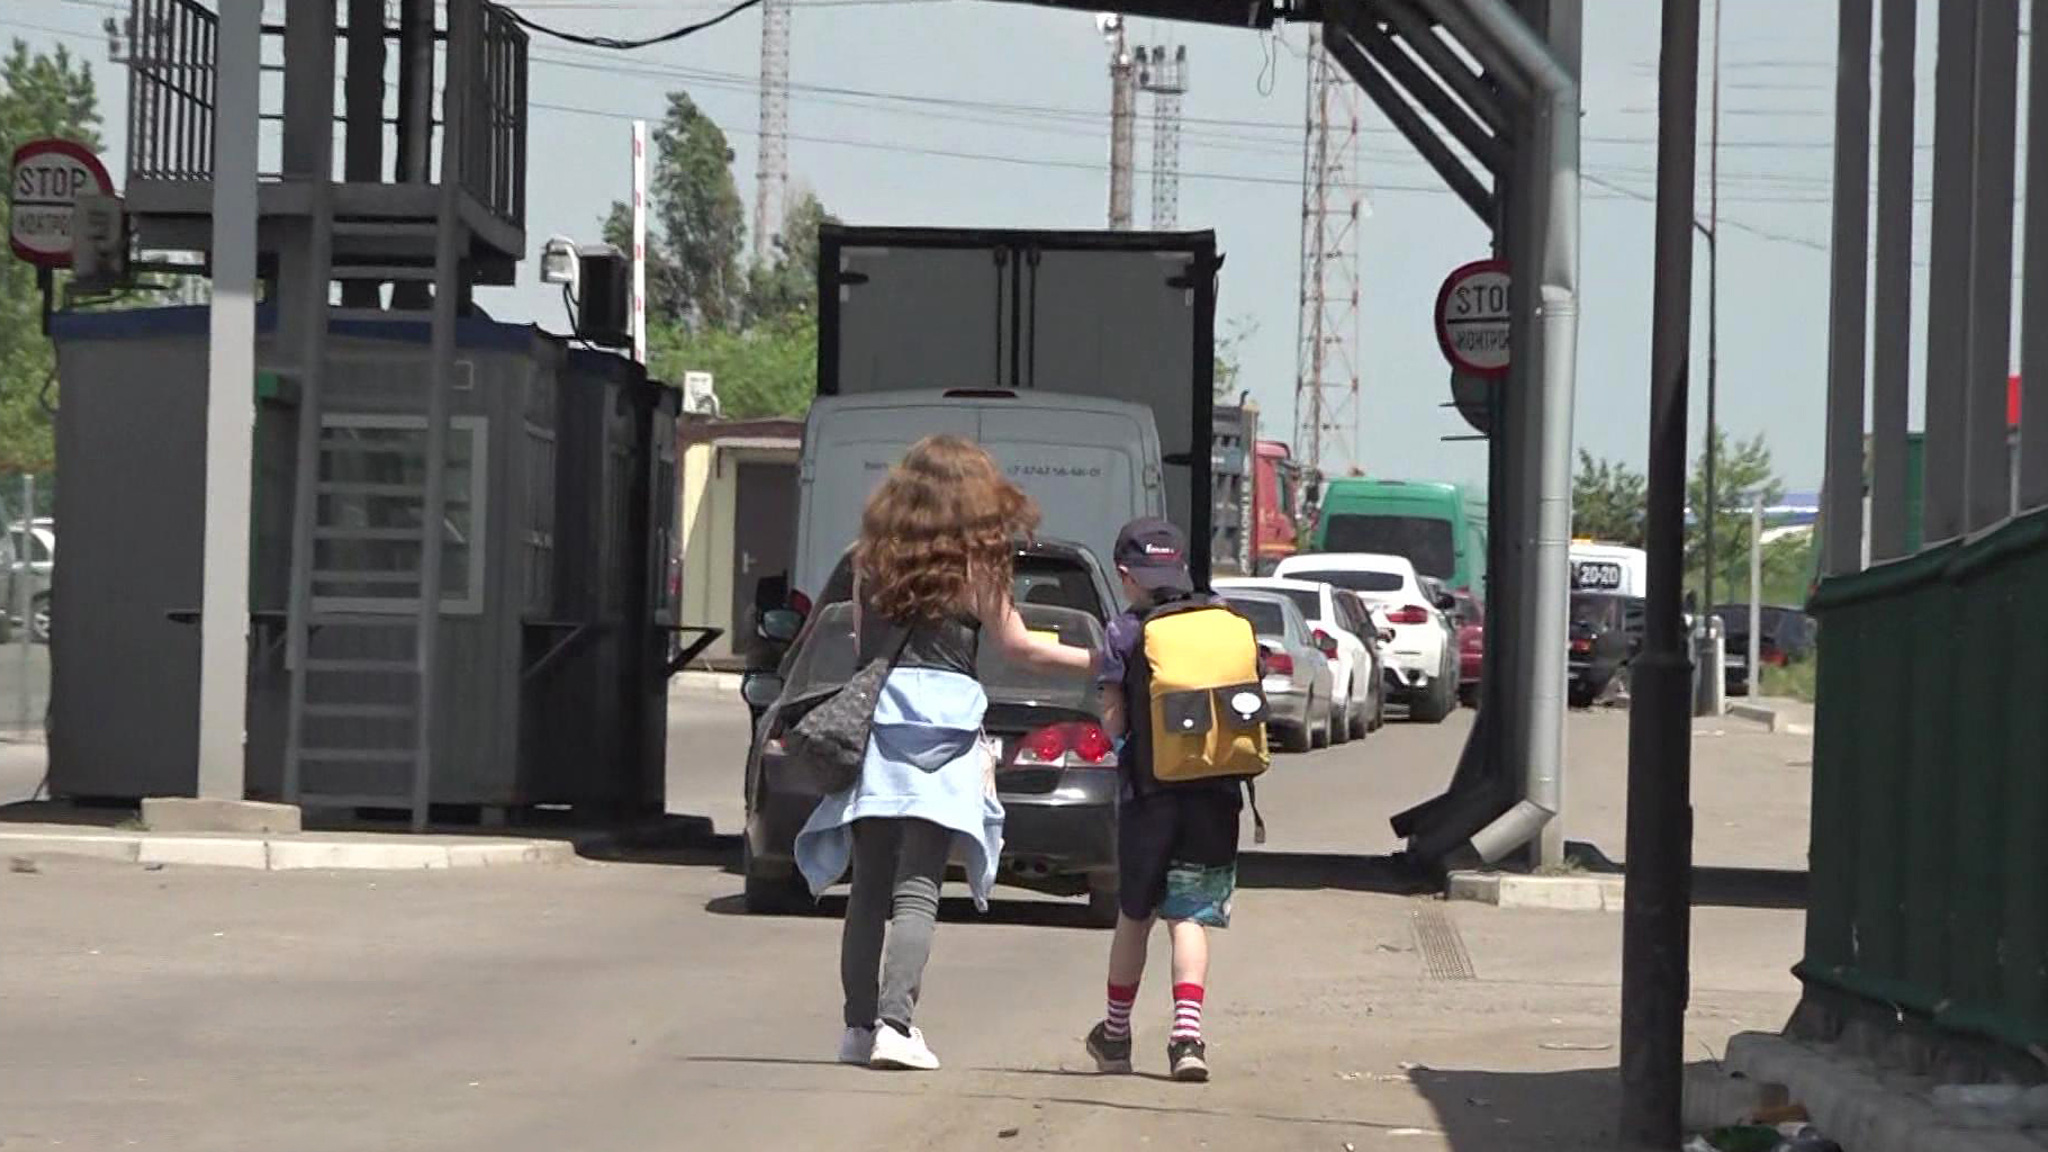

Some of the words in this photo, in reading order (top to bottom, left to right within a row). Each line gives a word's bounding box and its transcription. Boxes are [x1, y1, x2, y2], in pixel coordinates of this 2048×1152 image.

[19, 166, 87, 197] STOP
[1456, 285, 1509, 315] STO
[1580, 565, 1618, 585] 20-20
